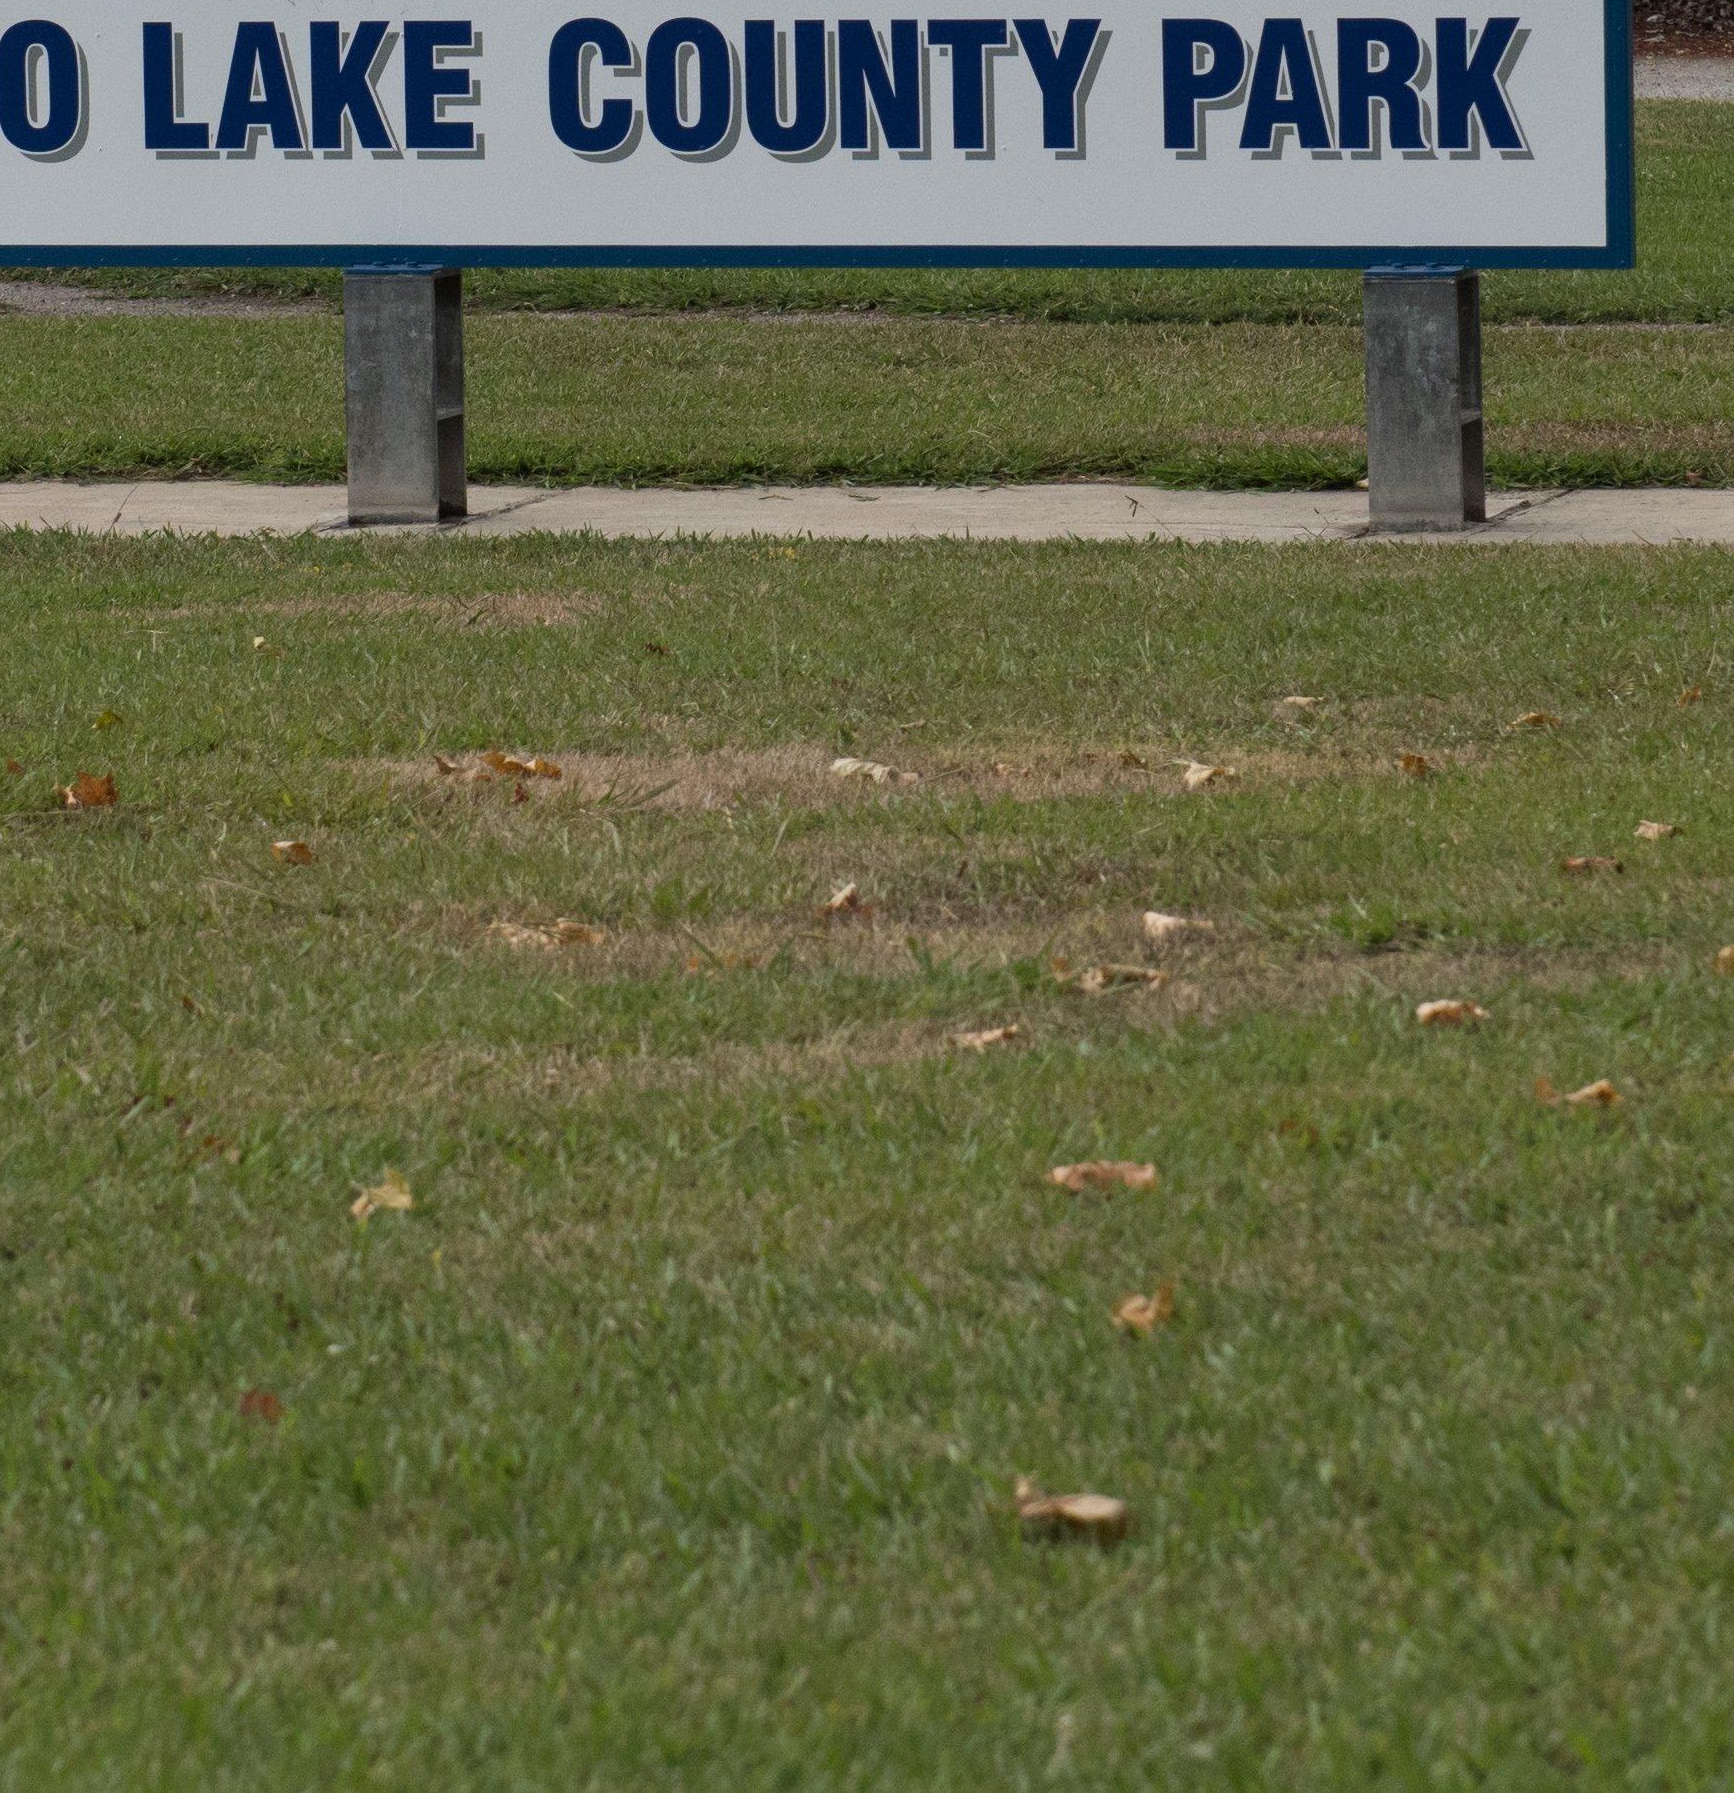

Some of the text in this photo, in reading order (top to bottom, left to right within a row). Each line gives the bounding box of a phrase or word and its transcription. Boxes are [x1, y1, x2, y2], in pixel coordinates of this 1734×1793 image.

[142, 20, 485, 160] LAKE
[548, 17, 1113, 163] COUNTY
[1161, 17, 1535, 160] PARK
